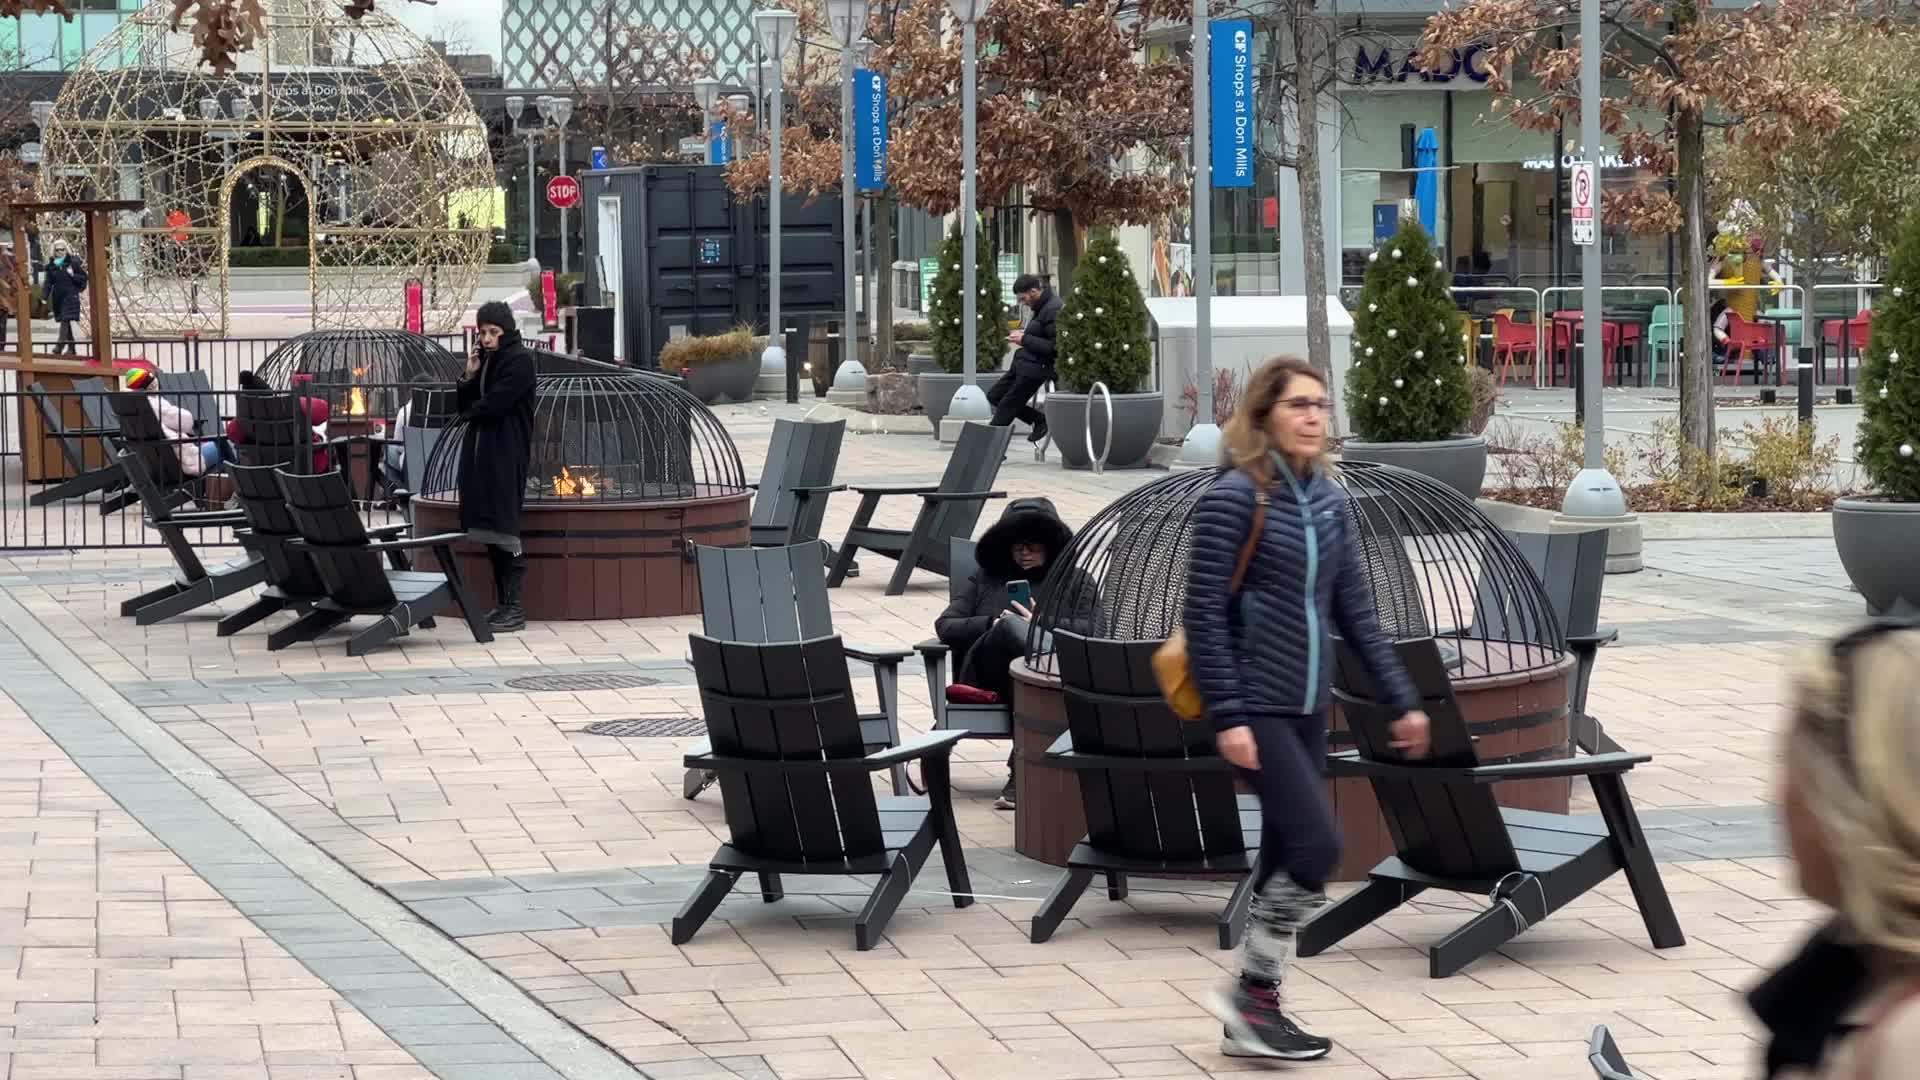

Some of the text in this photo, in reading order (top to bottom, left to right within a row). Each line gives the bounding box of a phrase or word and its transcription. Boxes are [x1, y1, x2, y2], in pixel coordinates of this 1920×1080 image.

[1233, 55, 1247, 97] Shops
[315, 85, 337, 96] Don
[871, 93, 881, 124] Shops
[1235, 101, 1245, 113] at
[873, 126, 880, 135] at
[1236, 116, 1247, 144] Don
[873, 136, 882, 157] Don
[1236, 147, 1247, 177] Mills
[550, 185, 576, 199] STOP
